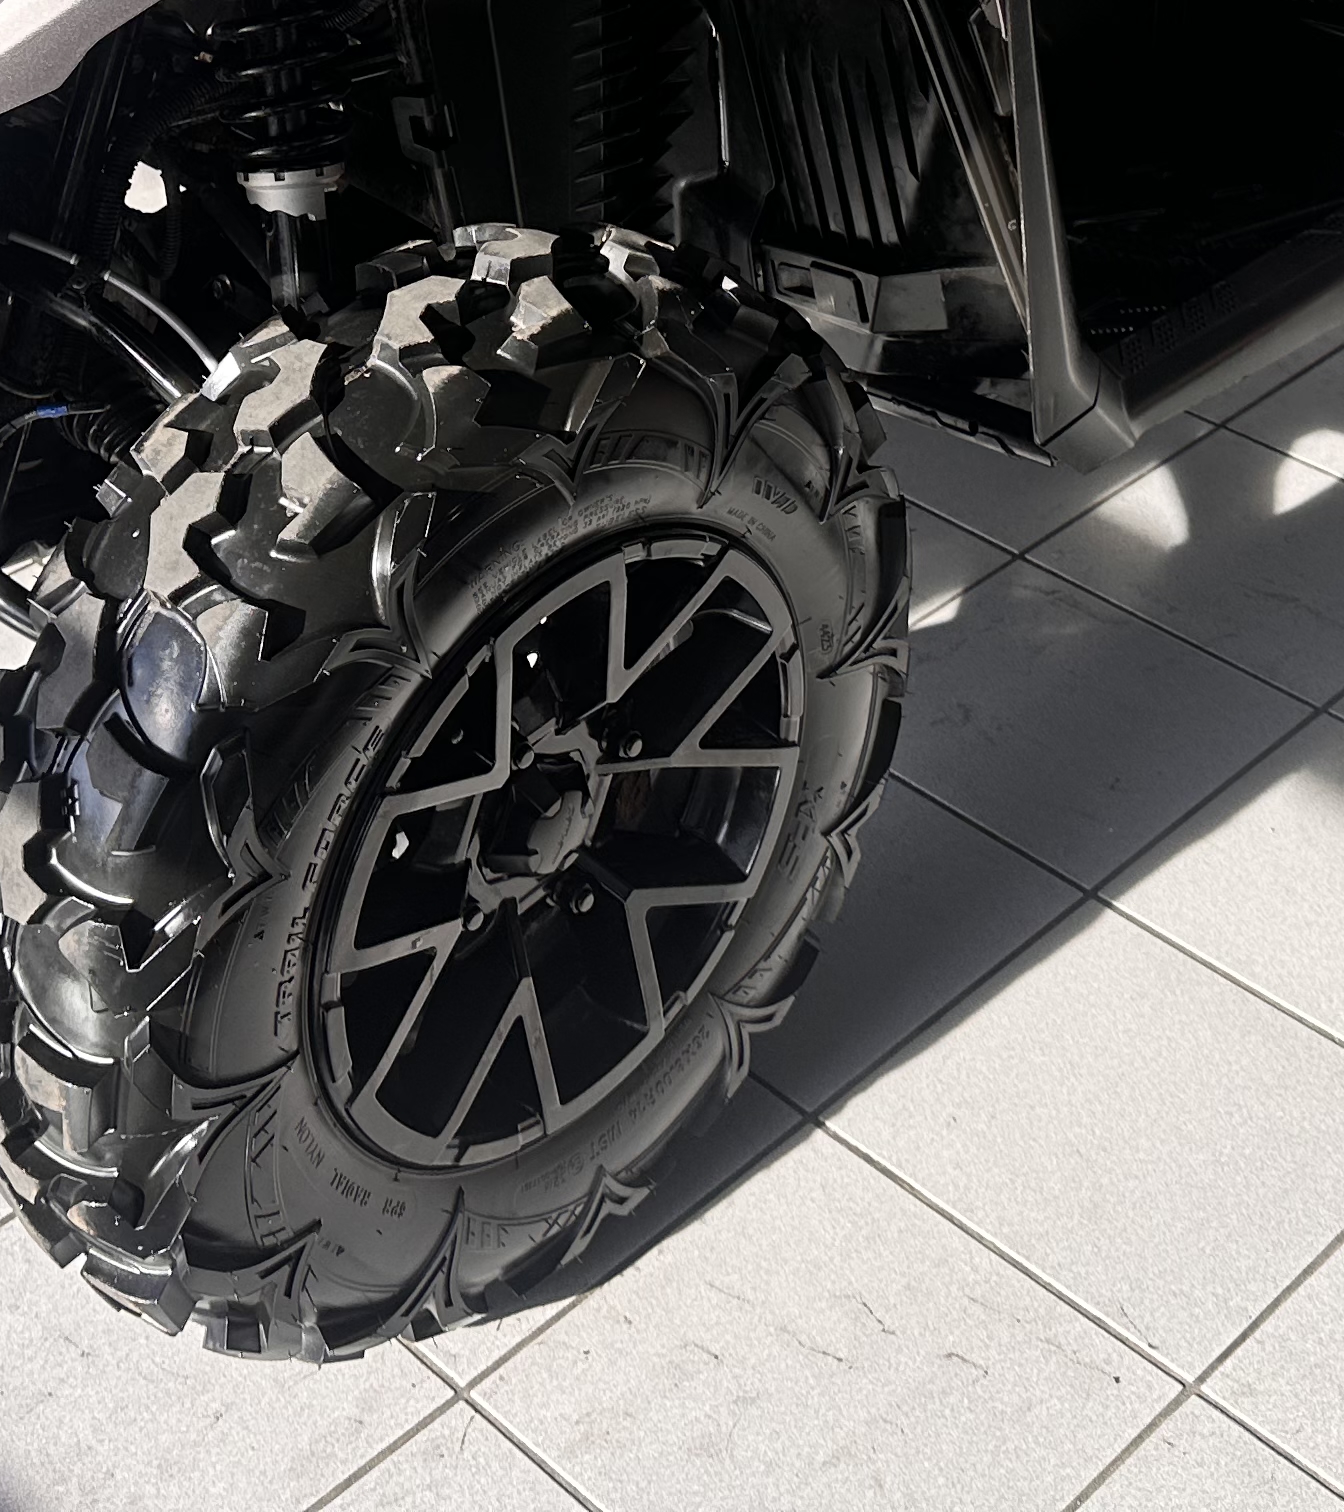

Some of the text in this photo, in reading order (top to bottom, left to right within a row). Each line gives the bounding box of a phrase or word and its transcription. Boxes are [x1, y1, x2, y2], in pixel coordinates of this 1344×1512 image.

[273, 724, 387, 1039] TRAIL FORCE
[293, 1115, 327, 1169] NYLON
